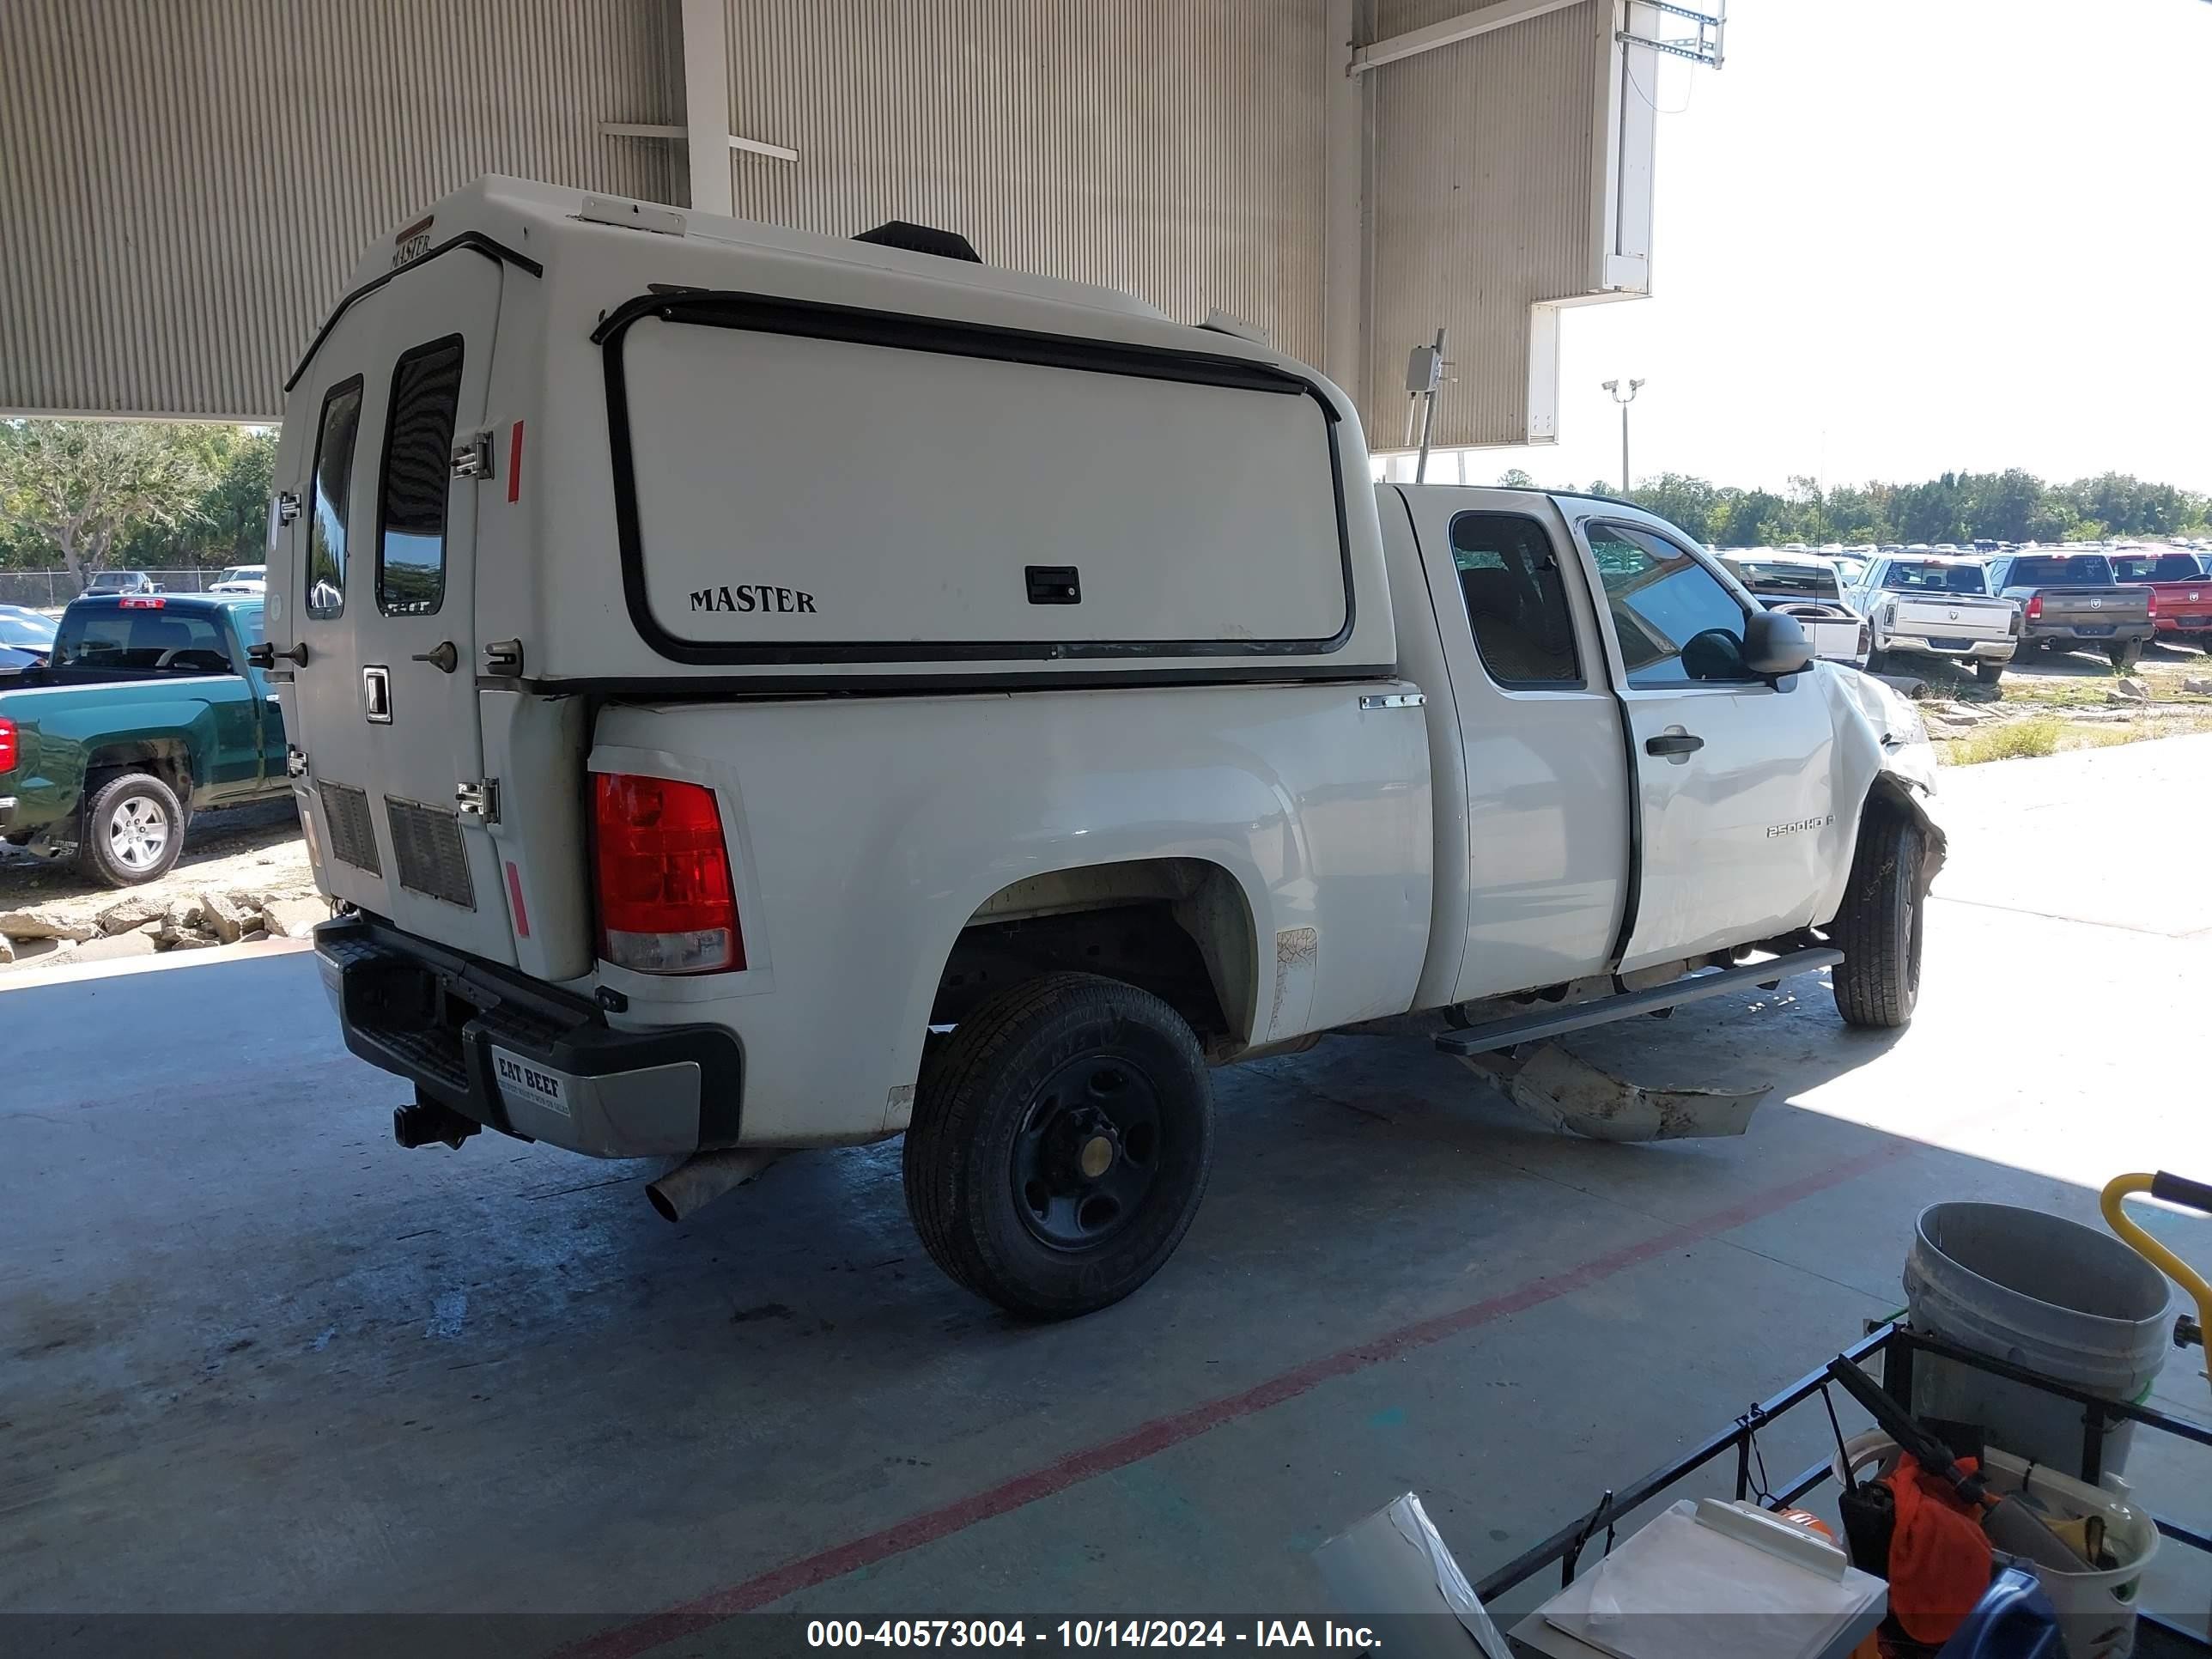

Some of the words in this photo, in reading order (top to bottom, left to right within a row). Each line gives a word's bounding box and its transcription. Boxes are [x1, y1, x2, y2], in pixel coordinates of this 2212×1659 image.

[391, 234, 431, 270] MASTER
[690, 585, 818, 613] MASTER
[1767, 817, 1823, 838] 2500HD
[498, 1057, 521, 1084] EAT
[524, 1067, 559, 1098] BEEF
